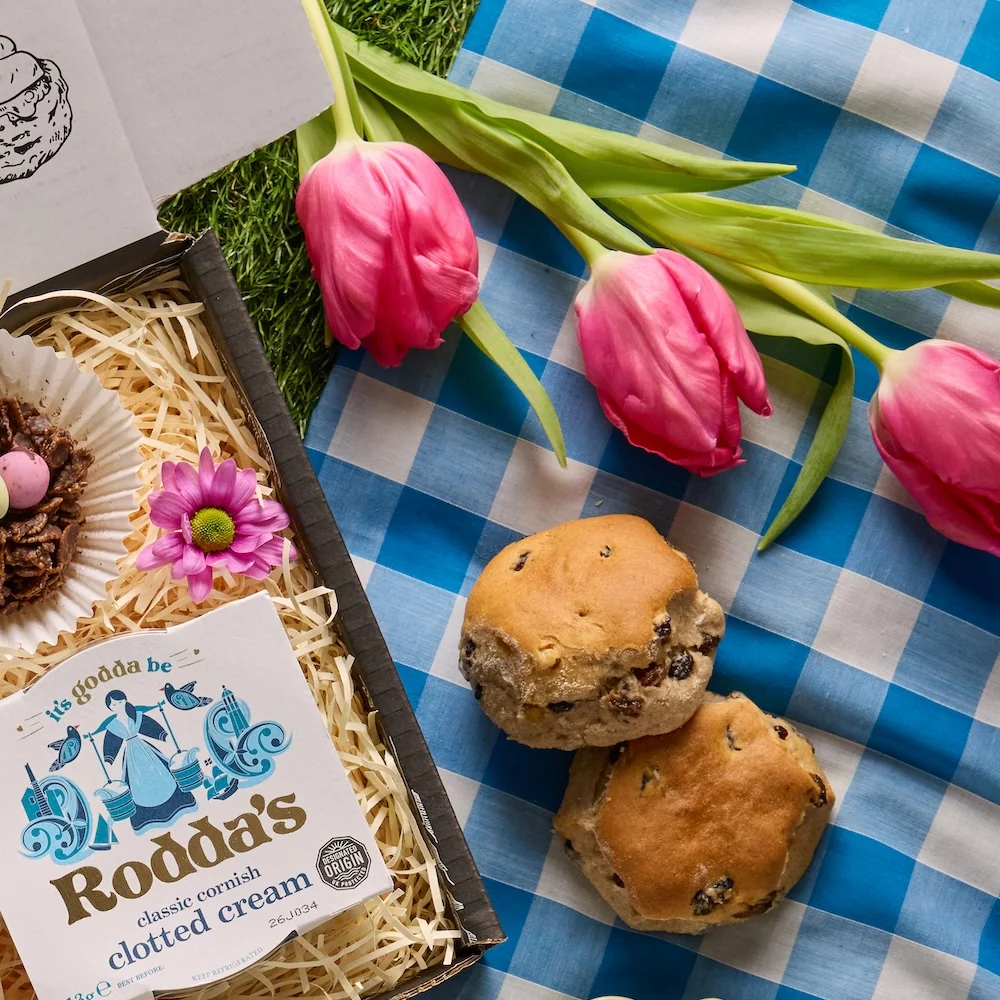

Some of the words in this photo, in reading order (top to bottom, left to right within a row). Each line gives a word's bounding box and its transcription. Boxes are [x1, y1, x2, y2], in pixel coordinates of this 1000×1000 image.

[45, 698, 72, 722] it's
[147, 657, 172, 673] be
[322, 845, 358, 865] DESIGNATED
[324, 851, 364, 877] ORIGIN
[137, 895, 193, 928] classic
[197, 866, 262, 902] cornish
[108, 908, 212, 970] clotted
[217, 872, 314, 923] cream
[192, 971, 211, 982] KEEP
[211, 947, 264, 977] REFRIGERATED
[117, 976, 134, 989] BEST
